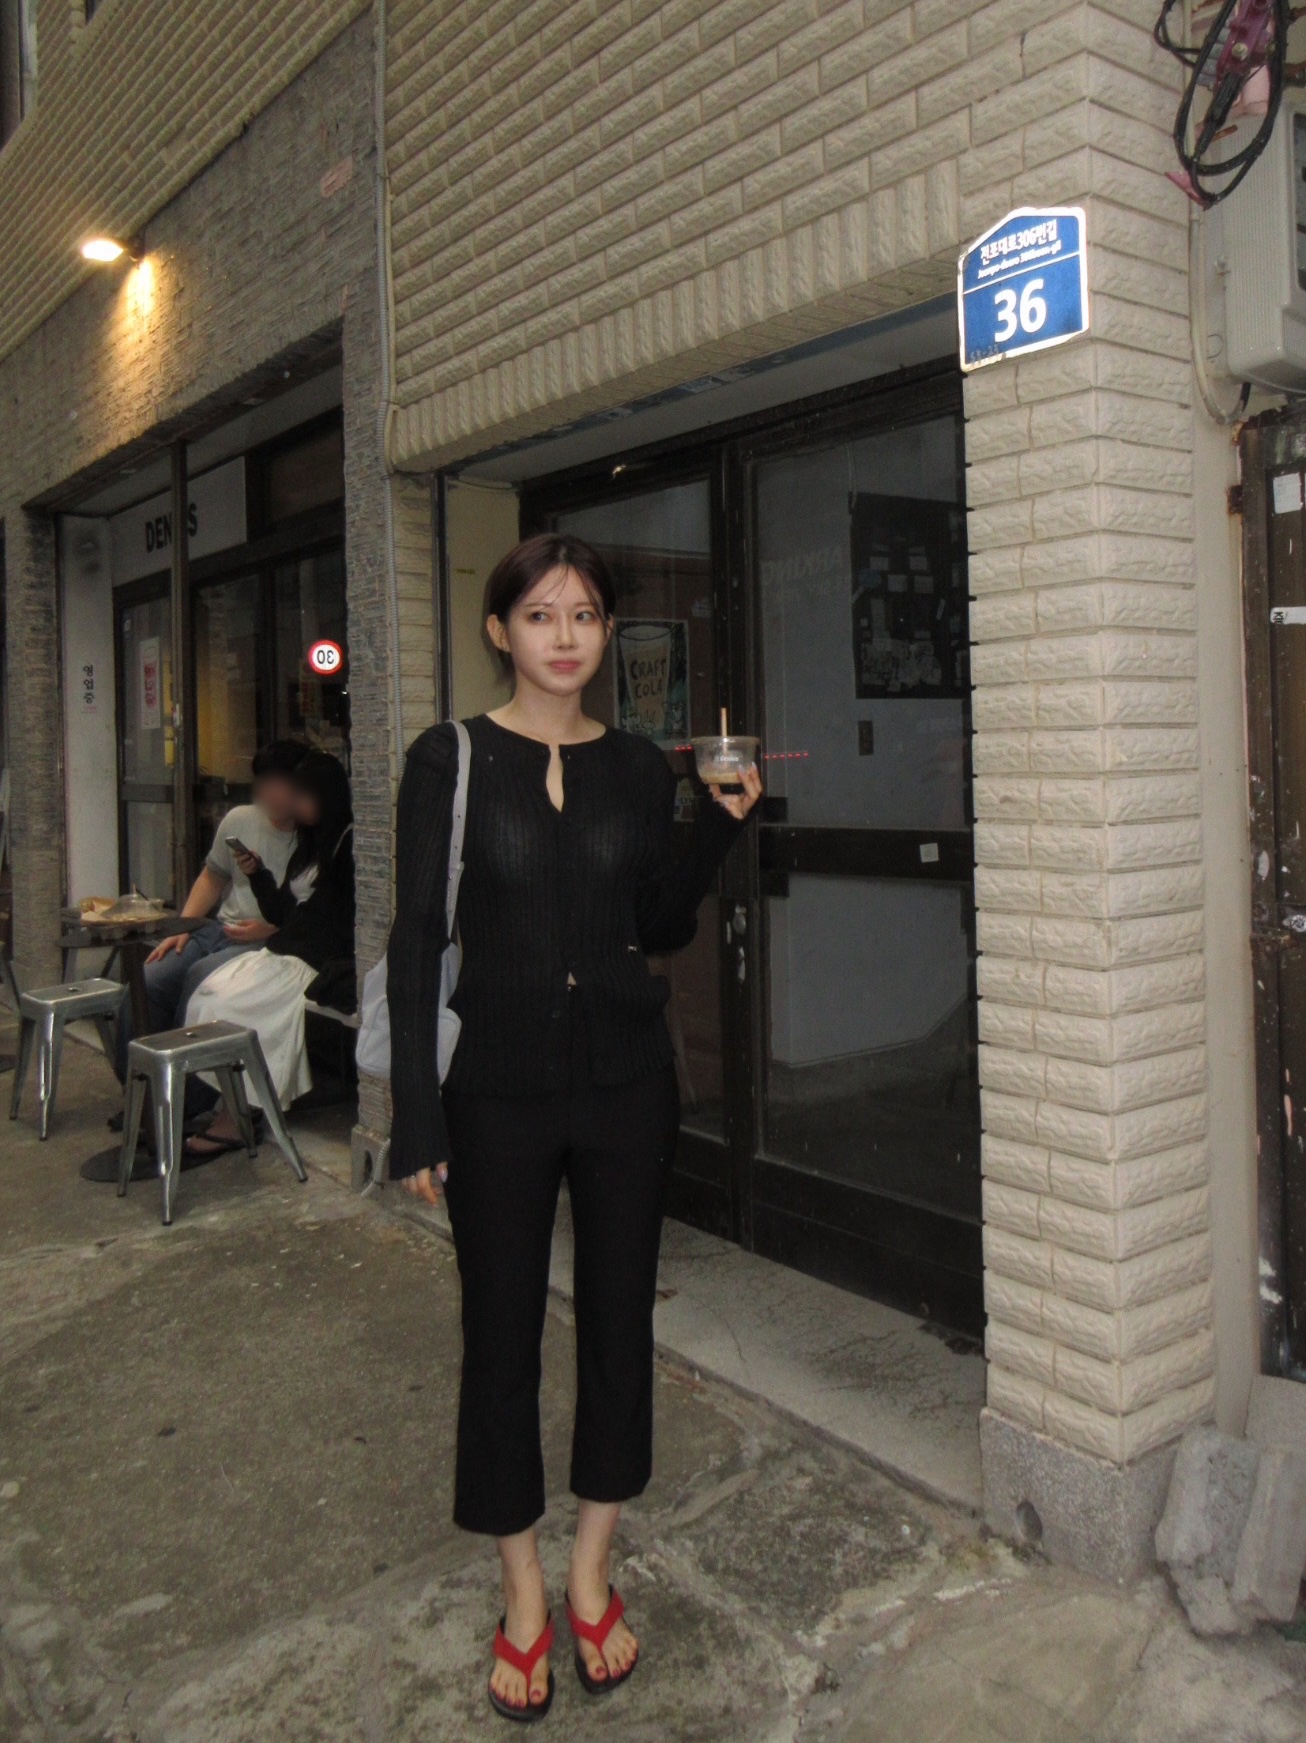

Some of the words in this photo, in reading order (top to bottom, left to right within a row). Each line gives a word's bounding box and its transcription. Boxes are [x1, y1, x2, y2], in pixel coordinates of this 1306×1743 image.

[994, 278, 1047, 343] 36
[629, 658, 667, 681] CRAFT
[633, 679, 664, 699] COLA
